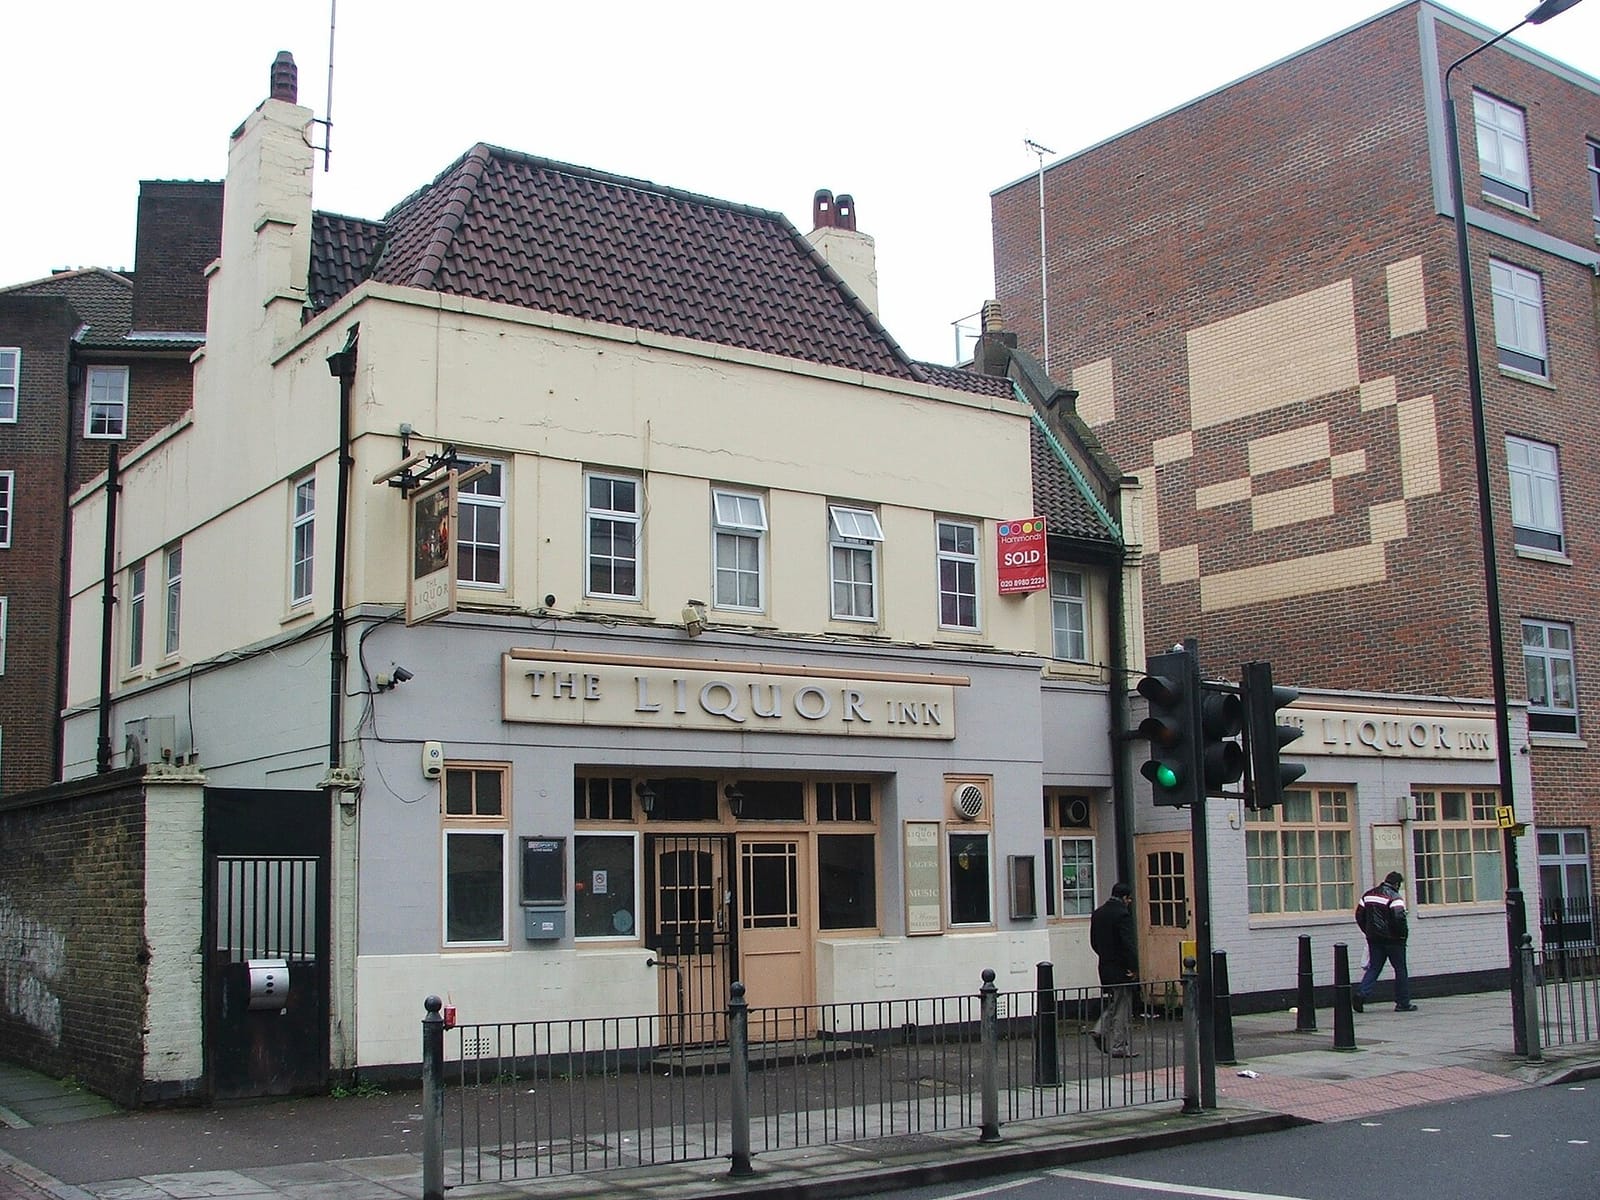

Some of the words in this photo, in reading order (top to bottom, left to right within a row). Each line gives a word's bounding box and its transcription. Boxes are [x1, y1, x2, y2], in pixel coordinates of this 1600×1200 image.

[1001, 534, 1041, 543] Hammonds
[1004, 550, 1040, 566] SOLD
[1000, 580, 1013, 588] 020
[414, 583, 449, 606] LIQUOR
[525, 669, 602, 701] THE
[634, 675, 872, 723] LIQUOR
[886, 700, 943, 726] INN
[1322, 718, 1451, 751] LIQUOR
[1458, 731, 1490, 751] INN
[1497, 808, 1511, 826] H
[908, 888, 939, 897] MUSIC
